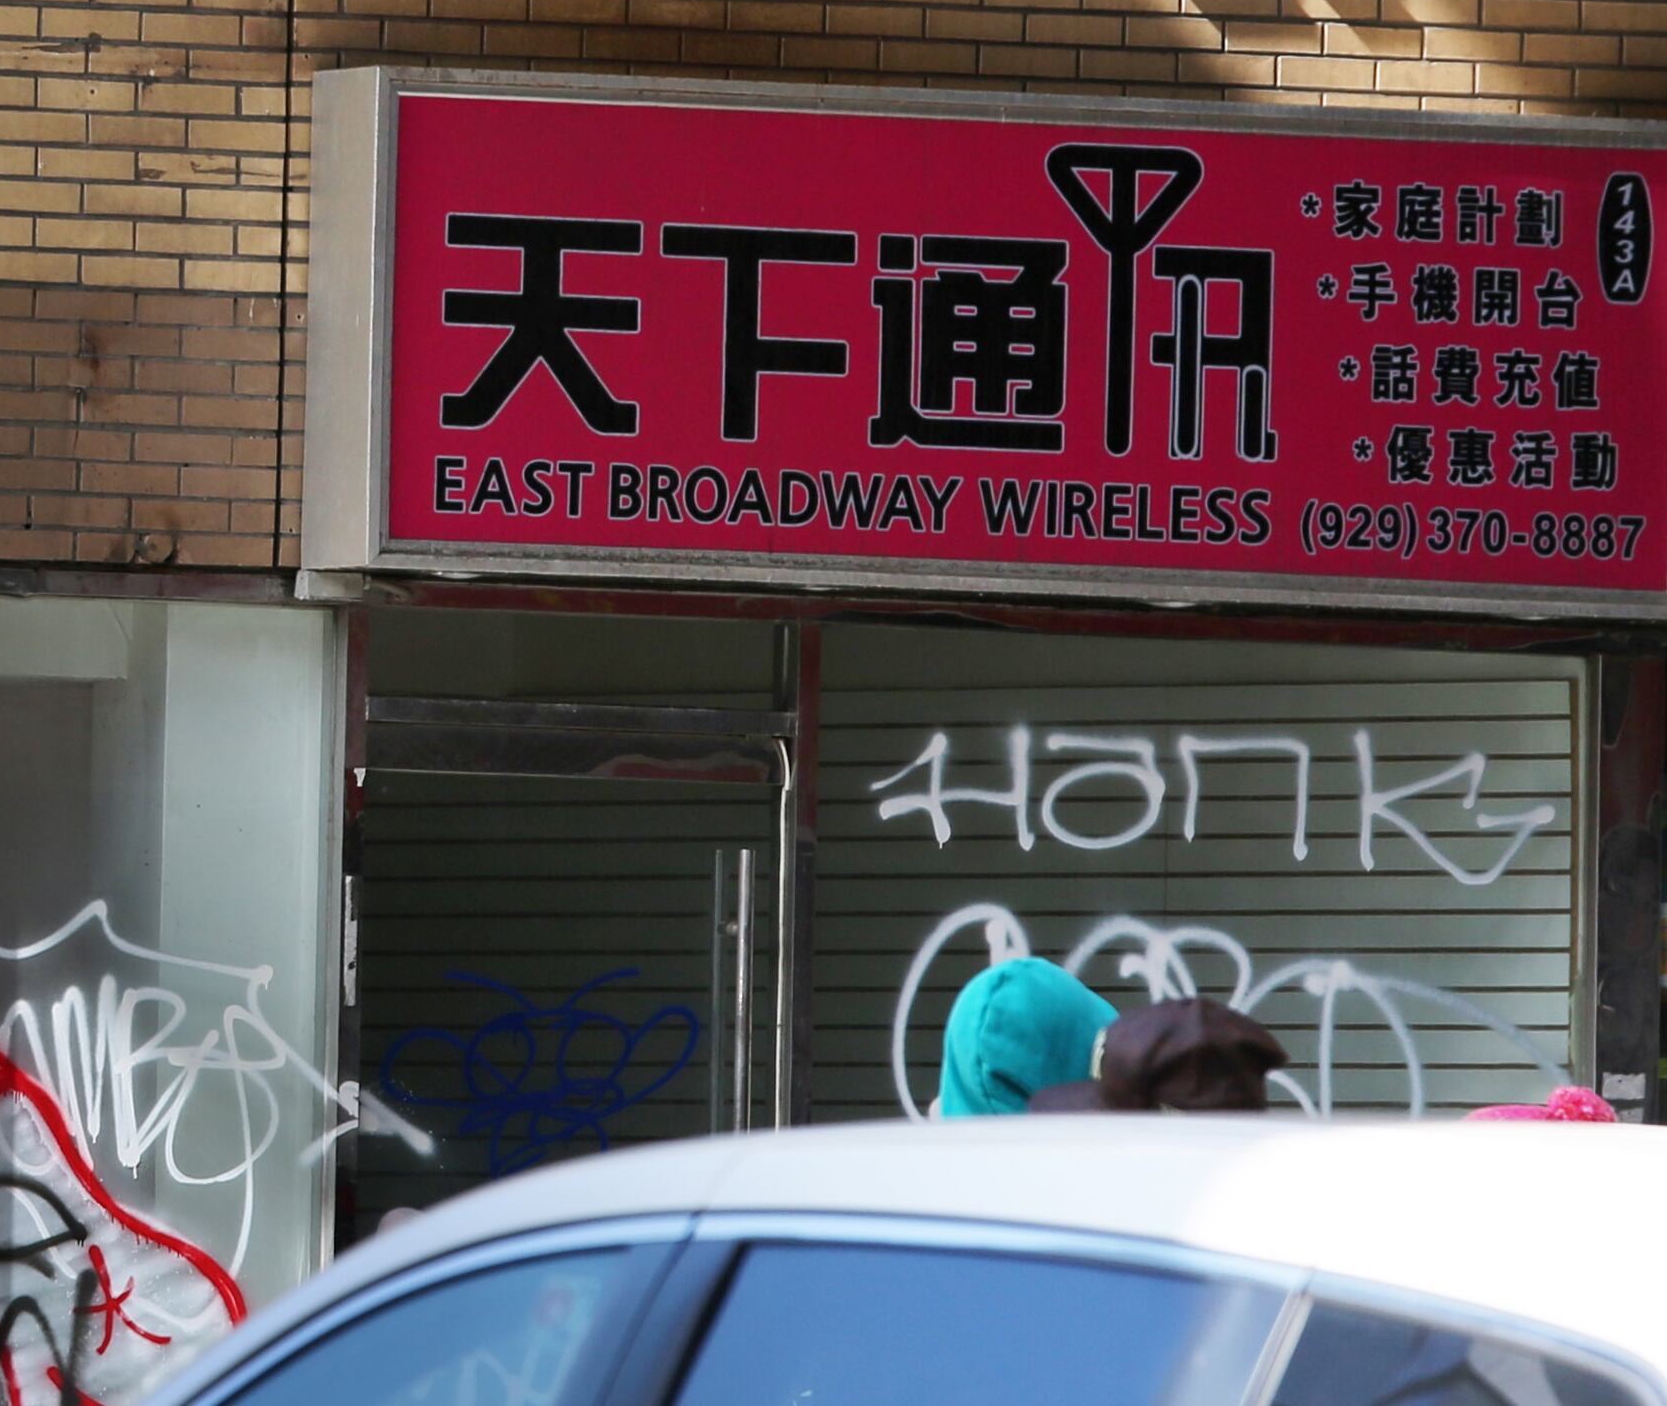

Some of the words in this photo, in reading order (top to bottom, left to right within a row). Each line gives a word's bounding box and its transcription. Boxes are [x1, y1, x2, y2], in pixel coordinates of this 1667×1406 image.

[1334, 180, 1564, 248] 家庭計劃
[1347, 262, 1583, 329] 手機開台
[1371, 344, 1600, 410] 話費充值
[1387, 426, 1618, 491] 優惠活動
[434, 456, 595, 520] EAST
[608, 462, 964, 534] BROADWAY
[979, 478, 1273, 547] WIRELESS
